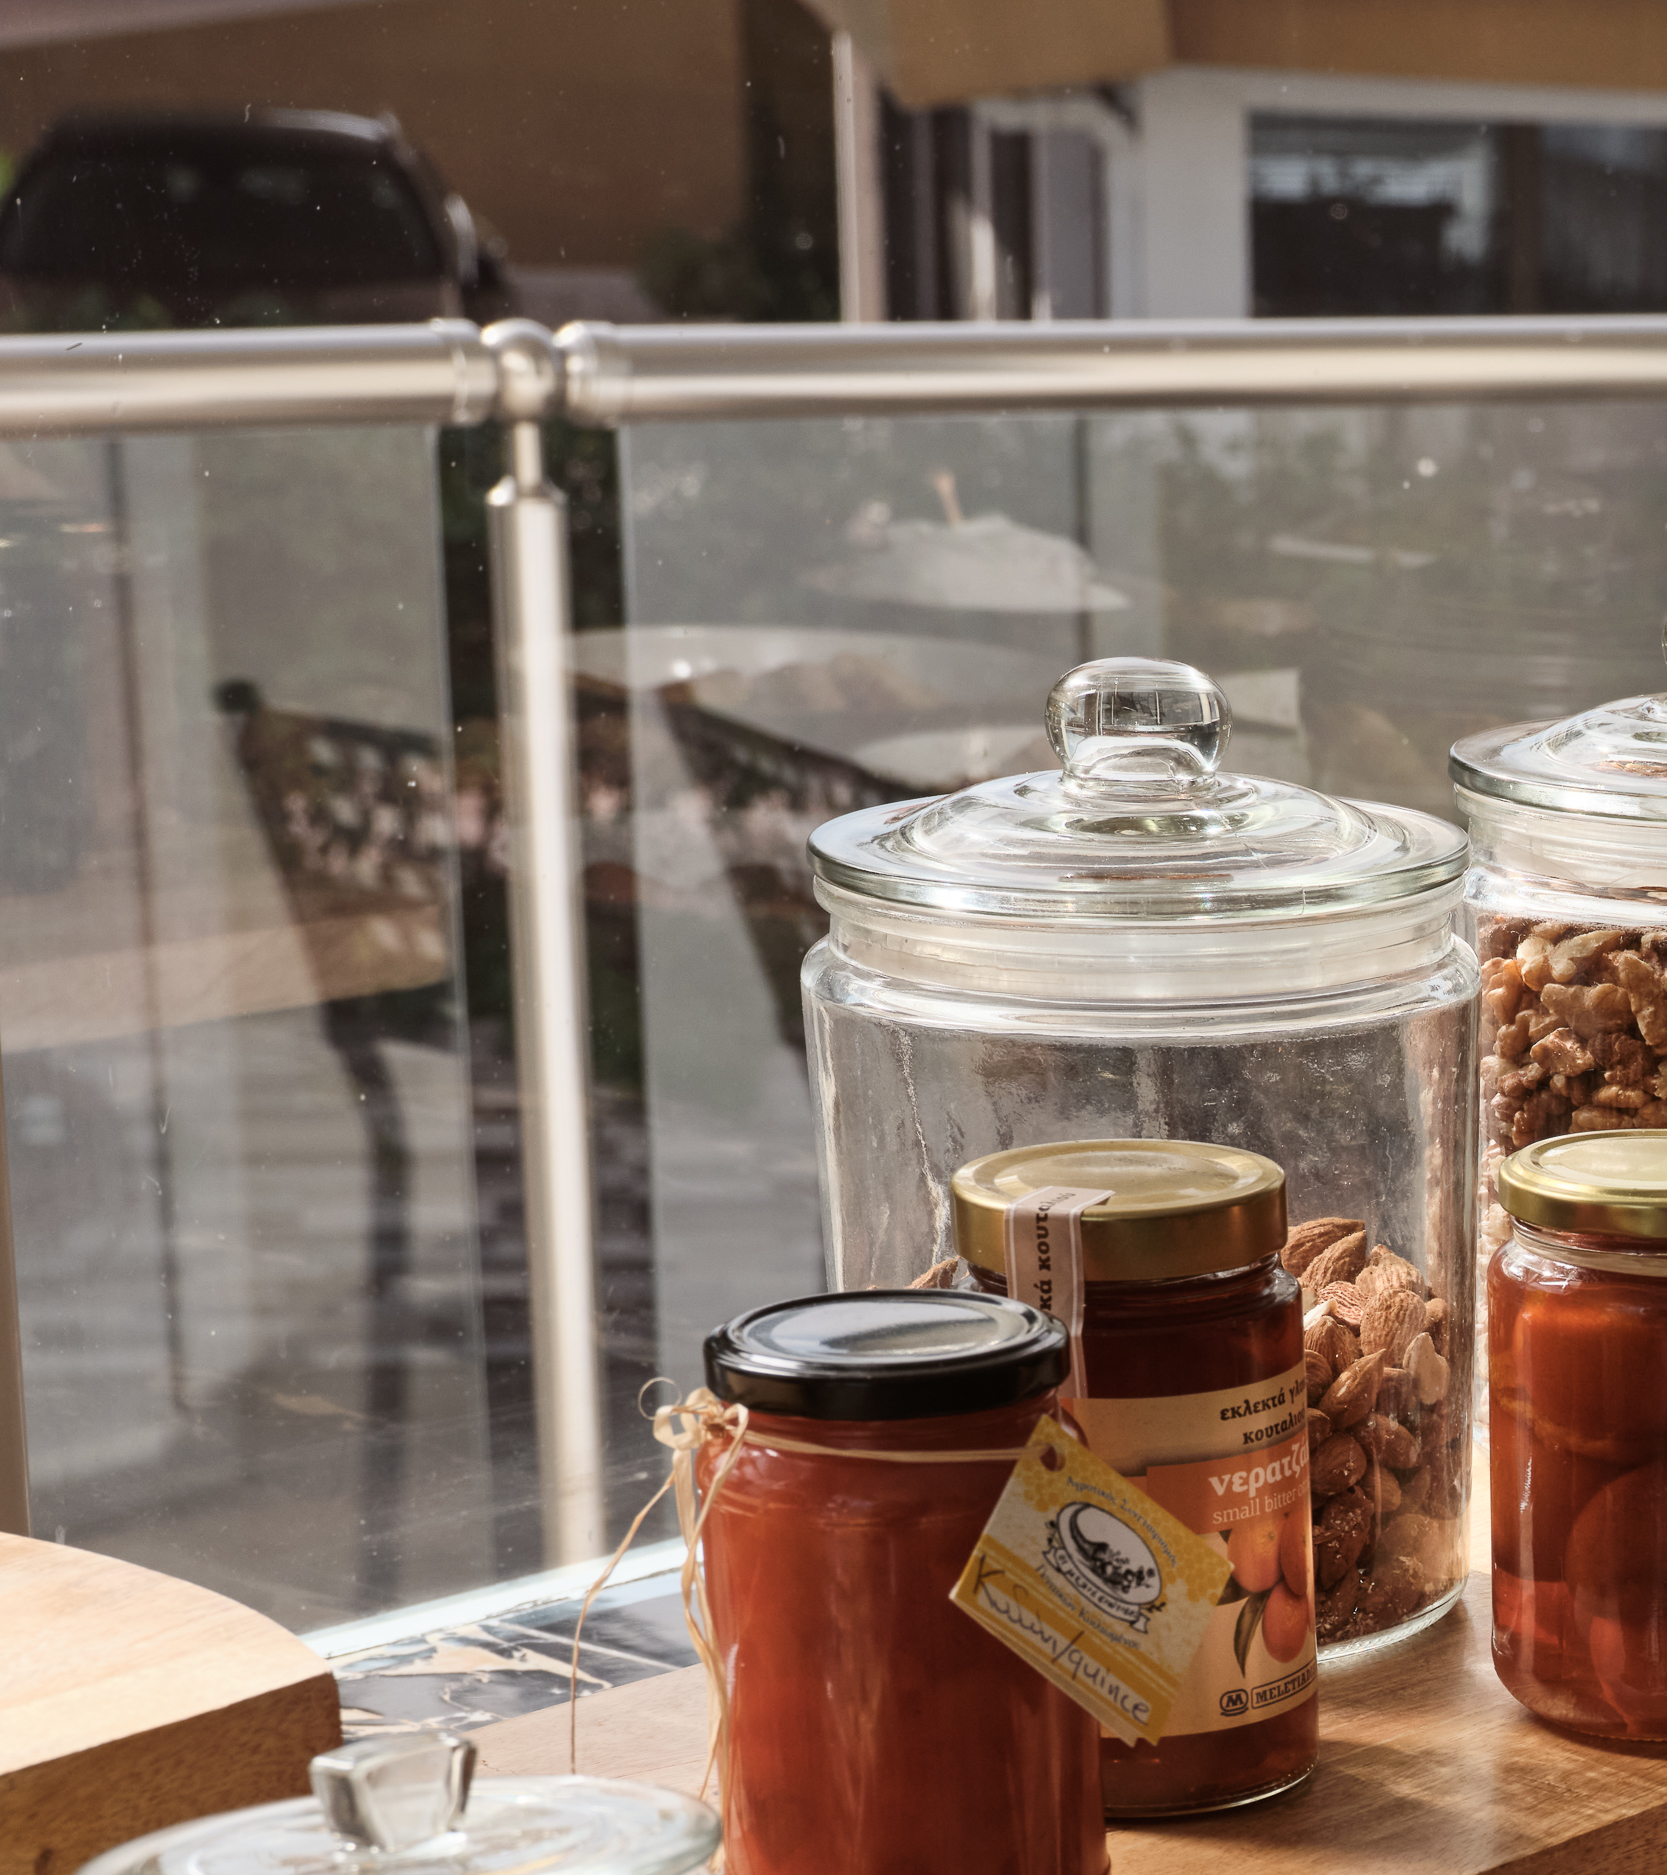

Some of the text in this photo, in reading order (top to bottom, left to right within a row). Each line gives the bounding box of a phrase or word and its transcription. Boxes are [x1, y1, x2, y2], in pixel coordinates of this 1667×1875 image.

[1220, 1387, 1286, 1421] εκλεκτά
[1213, 1498, 1260, 1525] small
[1265, 1487, 1296, 1513] bitter
